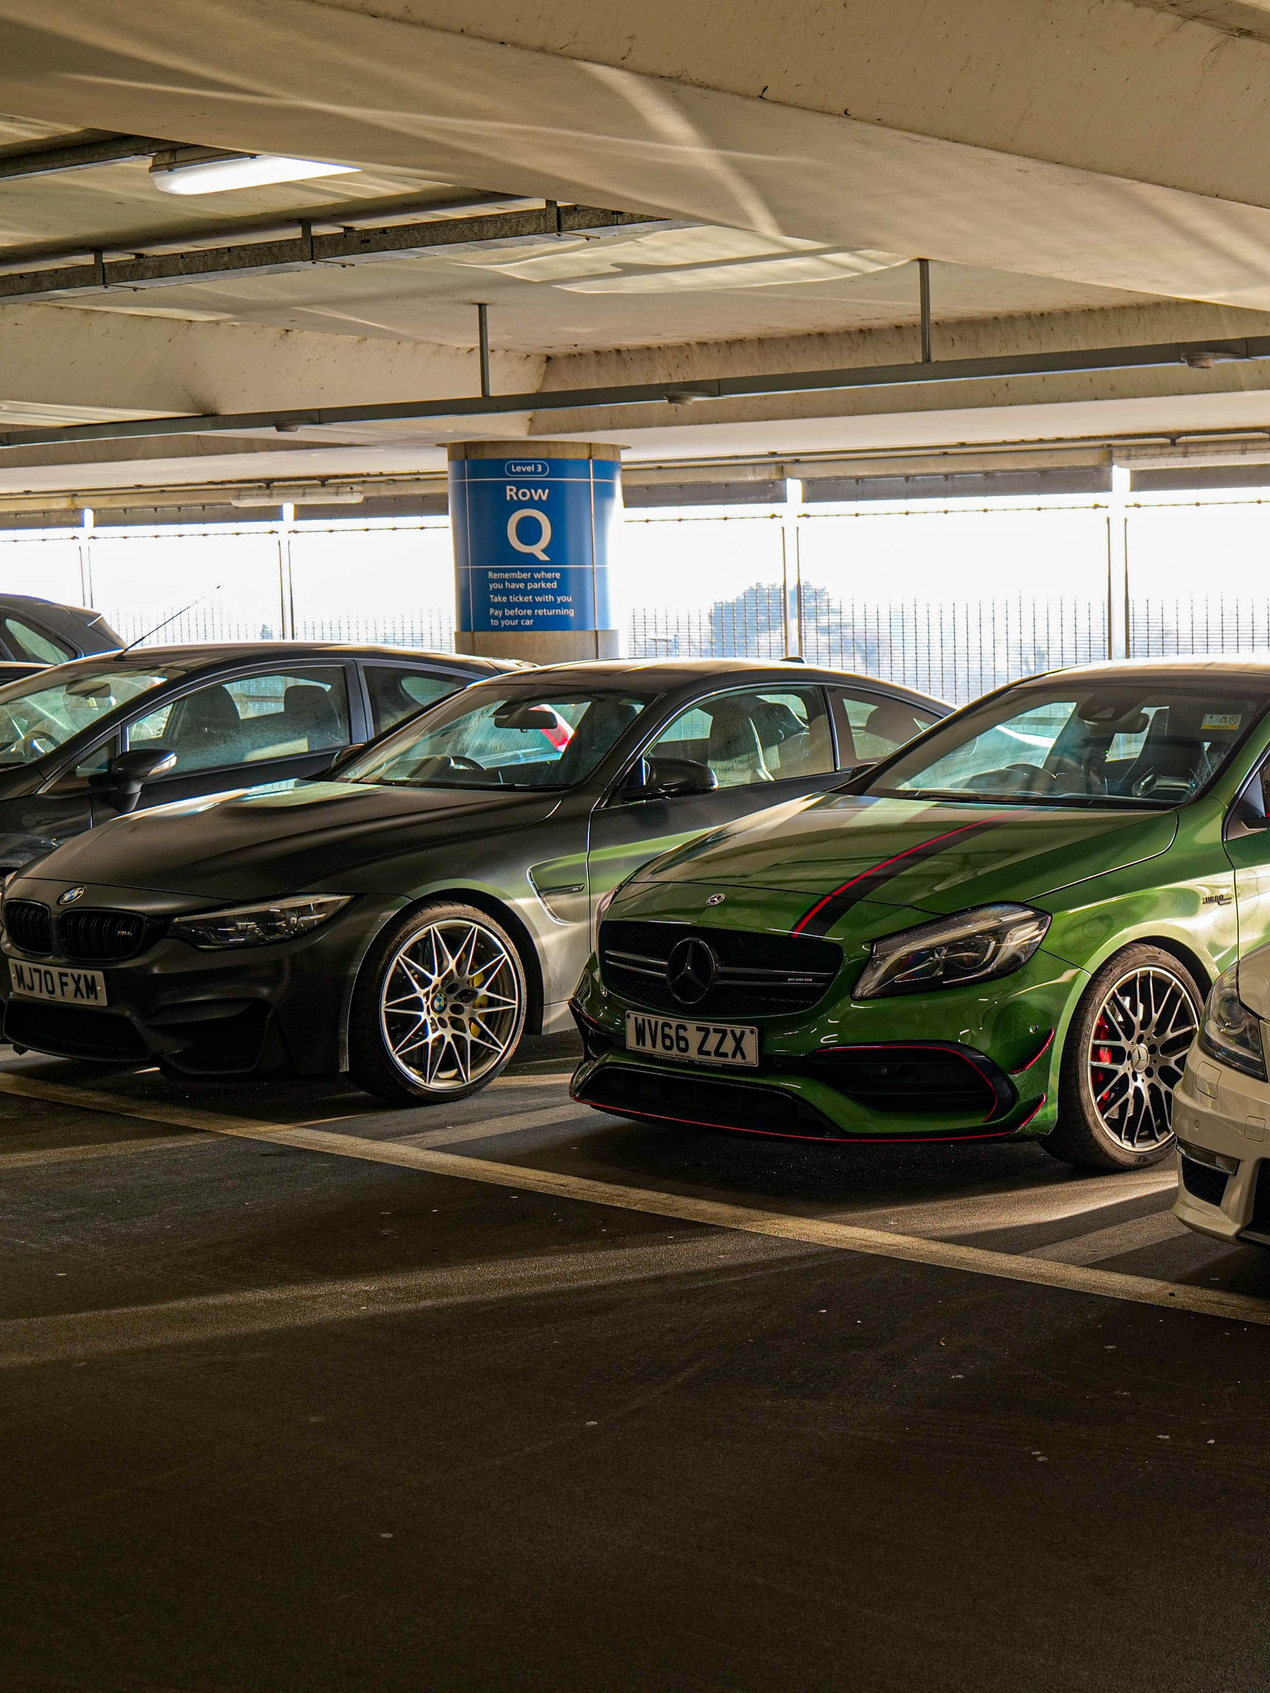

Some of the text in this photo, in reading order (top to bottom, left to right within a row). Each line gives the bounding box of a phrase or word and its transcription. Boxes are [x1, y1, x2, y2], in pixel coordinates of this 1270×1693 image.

[511, 464, 542, 473] Level 3
[506, 485, 549, 501] Row
[507, 508, 553, 561] Q
[488, 571, 561, 579] Remember where
[489, 581, 557, 590] you have parked
[490, 594, 572, 604] Take ticket with you
[490, 607, 575, 617] Pay before returning
[500, 619, 519, 628] your
[15, 963, 98, 1001] MJ70 FXM
[634, 1016, 747, 1060] WV66 ZZX
